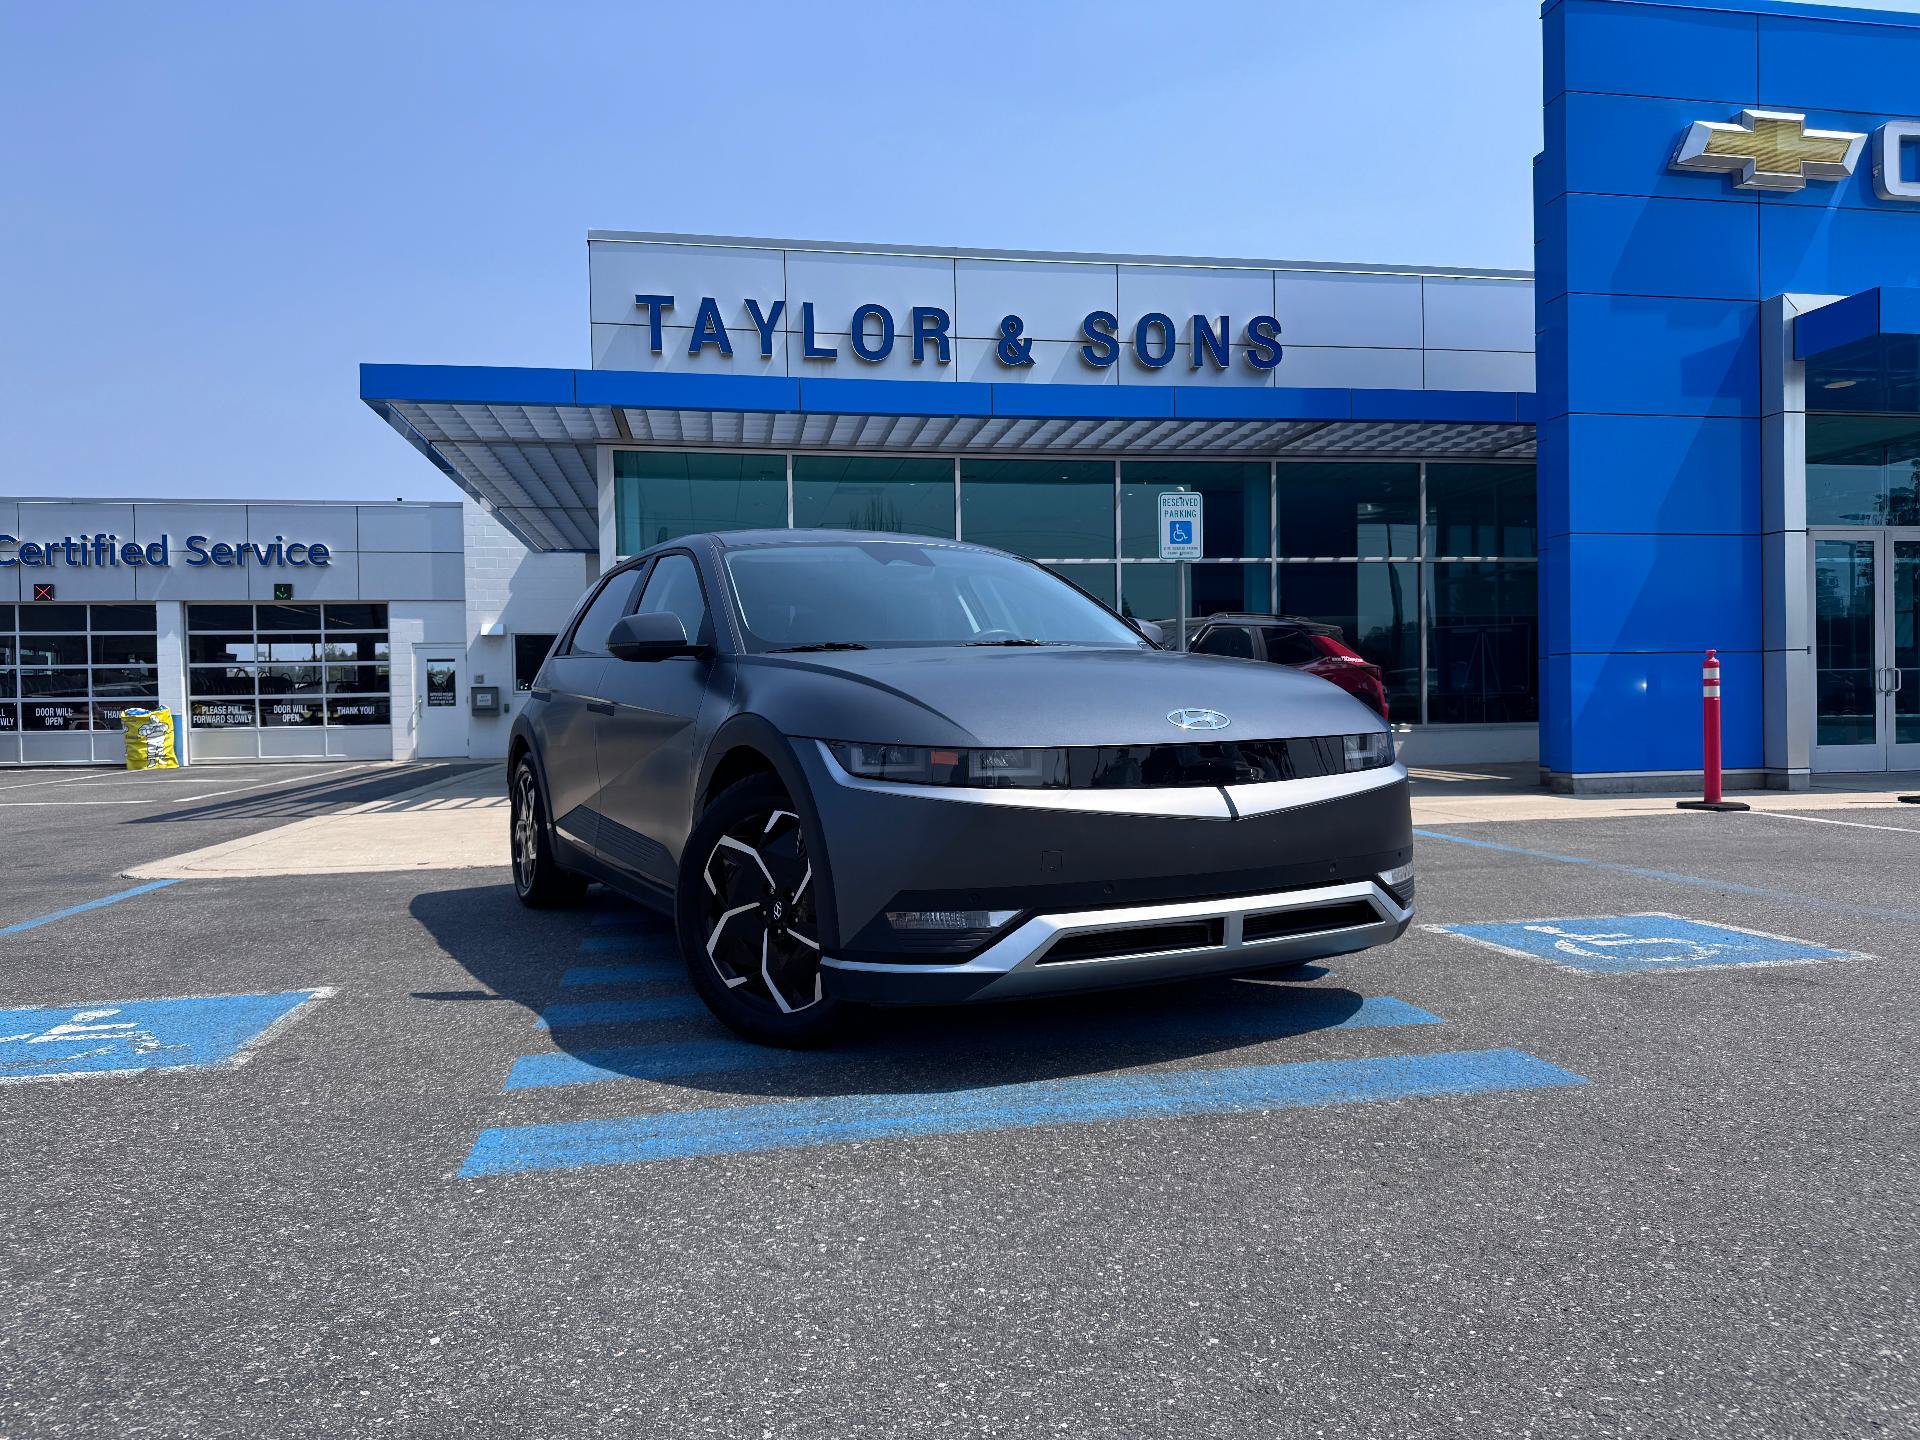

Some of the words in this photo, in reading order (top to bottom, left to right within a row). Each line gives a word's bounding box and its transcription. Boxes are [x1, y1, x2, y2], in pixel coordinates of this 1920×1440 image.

[635, 294, 951, 364] TAYLOR
[996, 314, 1035, 367] &
[1079, 310, 1284, 370] SONS
[1162, 498, 1199, 507] RESERVED
[1164, 509, 1197, 518] PARKING
[0, 533, 170, 567] Certified
[185, 534, 331, 567] Service
[35, 707, 55, 717] DOOR
[55, 707, 73, 717] WILL
[201, 705, 227, 715] PLEASE
[227, 705, 244, 714] PULL
[273, 704, 292, 714] DOOR
[292, 704, 309, 713] WILL
[336, 705, 359, 715] THANK
[360, 705, 375, 715] YOU!
[103, 710, 122, 719] THAN
[193, 715, 226, 724] FORWARD
[226, 714, 252, 723] SLOWLY
[282, 713, 300, 723] OPEN
[45, 716, 64, 726] OPEN
